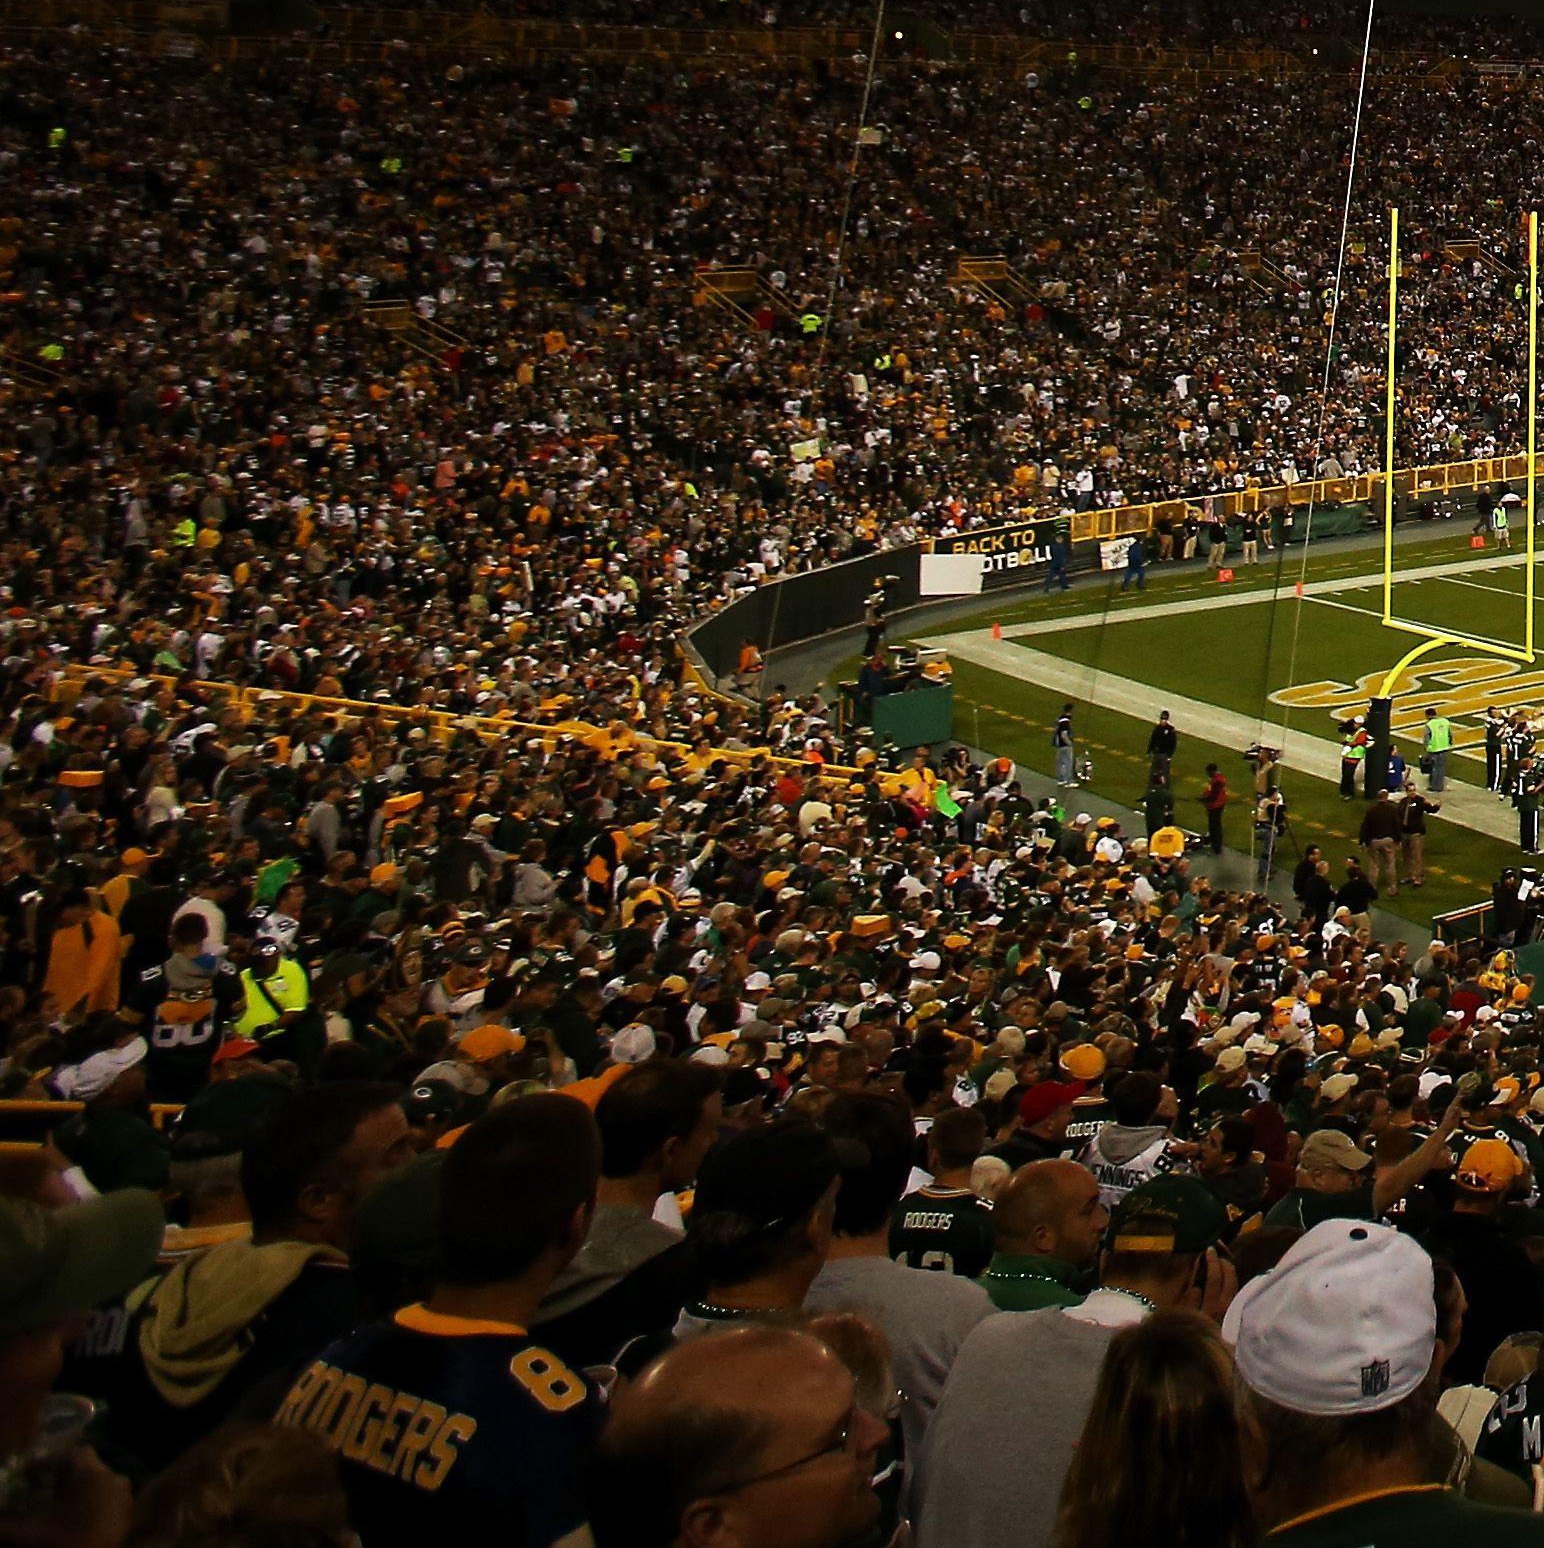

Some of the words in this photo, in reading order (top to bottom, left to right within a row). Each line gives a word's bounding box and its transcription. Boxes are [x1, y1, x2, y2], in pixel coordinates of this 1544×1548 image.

[952, 535, 1005, 554] BACK
[1010, 529, 1036, 545] TO
[902, 1211, 954, 1231] RODGERS
[509, 1345, 587, 1413] 8
[273, 1359, 478, 1493] RODGERS
